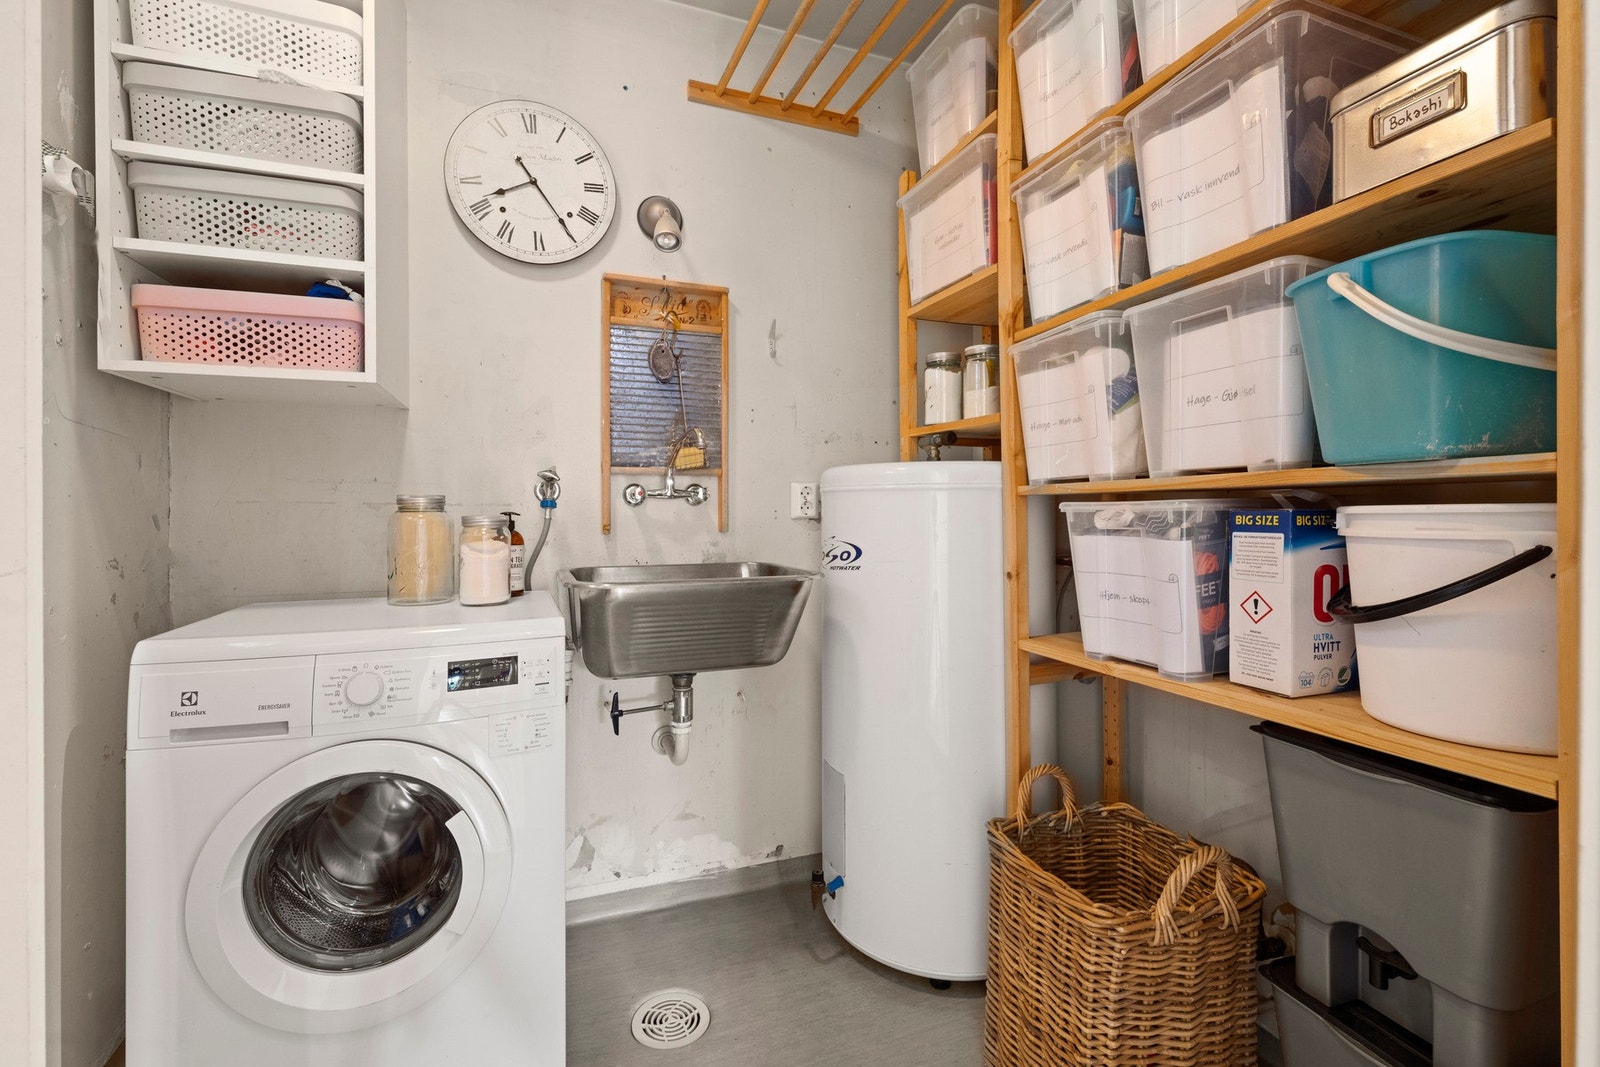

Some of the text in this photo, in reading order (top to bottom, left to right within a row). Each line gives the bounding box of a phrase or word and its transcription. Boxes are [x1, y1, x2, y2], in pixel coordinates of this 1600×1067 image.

[1389, 96, 1442, 130] Bokashi
[1151, 197, 1163, 211] Bil
[1177, 185, 1203, 202] vask
[1186, 394, 1211, 407] Hage
[1222, 385, 1256, 402] Gjøsel
[1235, 515, 1280, 526] BIG SIZE
[1296, 515, 1311, 526] BIG
[1313, 633, 1334, 641] ULTRA
[1313, 641, 1341, 653] HVITT
[1313, 653, 1333, 661] PULVER
[1300, 679, 1312, 687] 104
[257, 703, 291, 711] ENERGYSAVER
[170, 709, 206, 718] Electrolux
